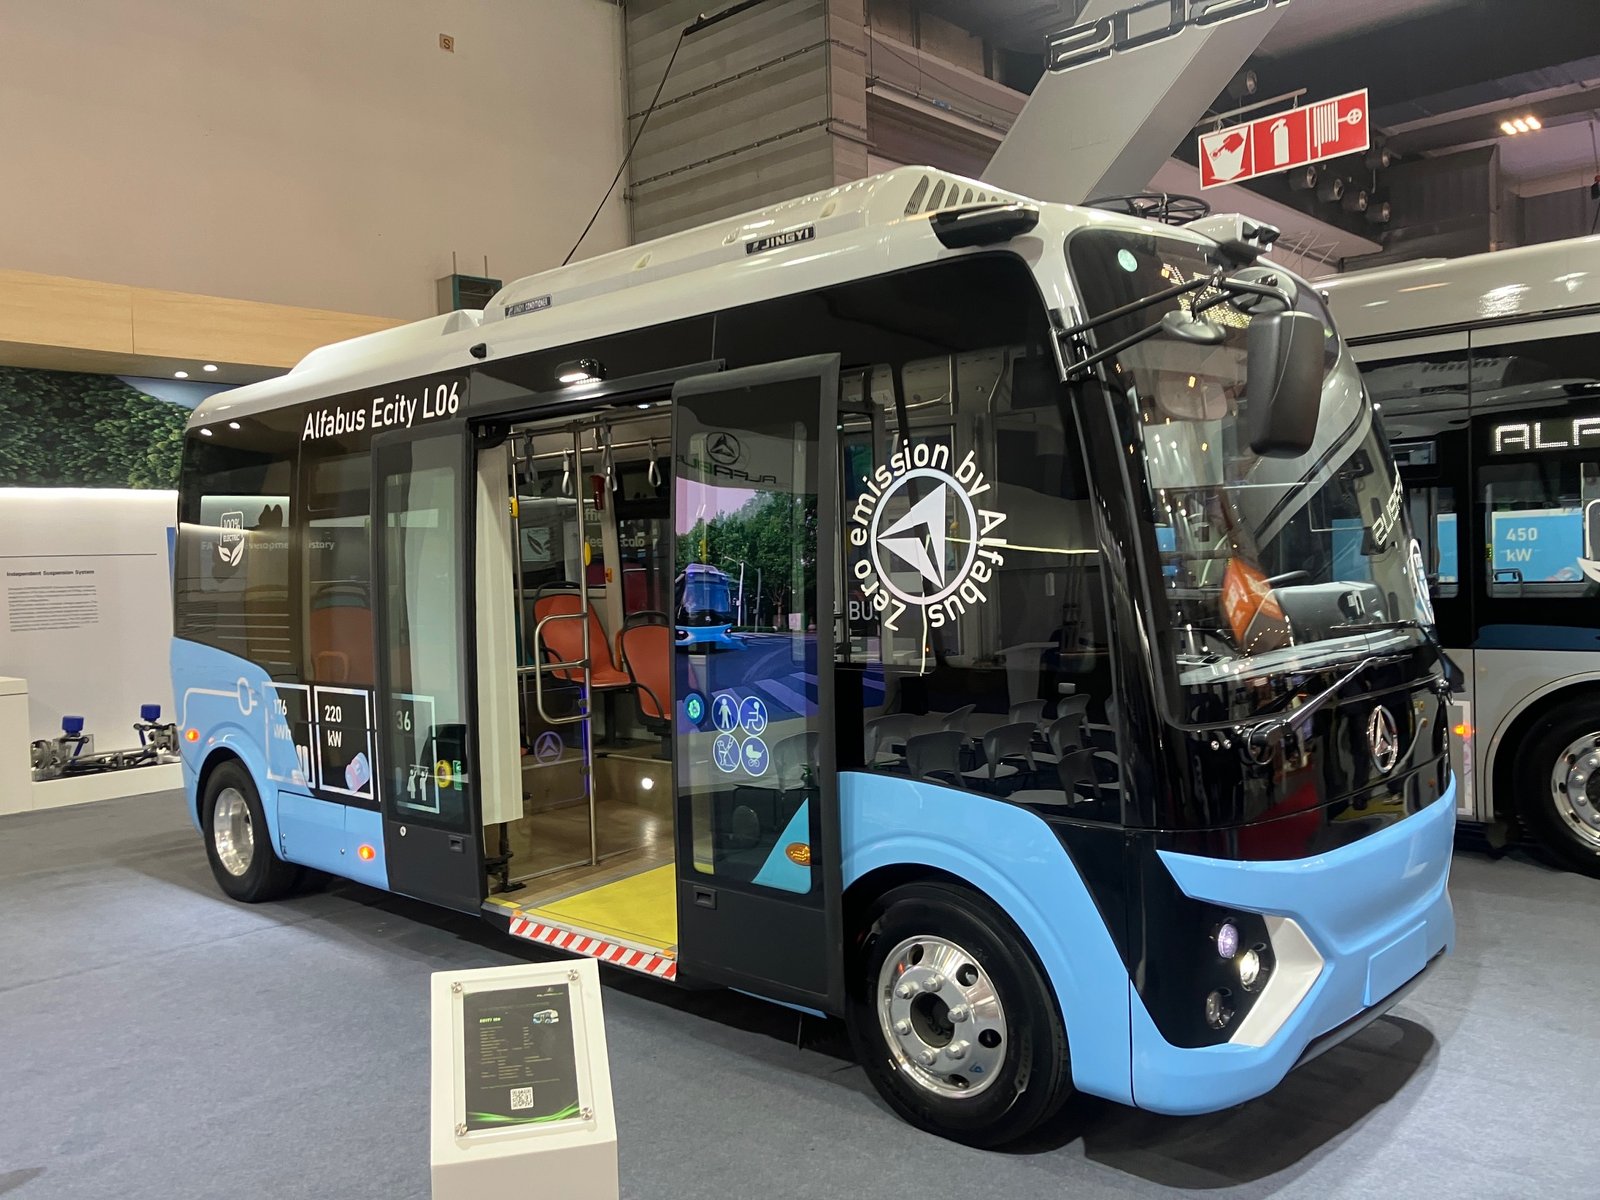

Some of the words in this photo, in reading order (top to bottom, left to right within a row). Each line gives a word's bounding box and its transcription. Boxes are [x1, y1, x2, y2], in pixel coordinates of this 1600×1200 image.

[761, 228, 809, 250] JINGYI
[302, 405, 366, 441] Alfabus
[371, 396, 416, 429] Ecity
[423, 382, 460, 419] L06
[955, 450, 991, 497] by
[850, 439, 949, 546] emission
[1506, 527, 1538, 541] 450
[1506, 548, 1533, 562] kW
[928, 508, 1007, 628] Alfabus
[854, 562, 907, 631] Zero
[849, 600, 879, 621] BU
[324, 705, 342, 723] 220
[396, 710, 411, 731] 36
[327, 729, 342, 748] kW
